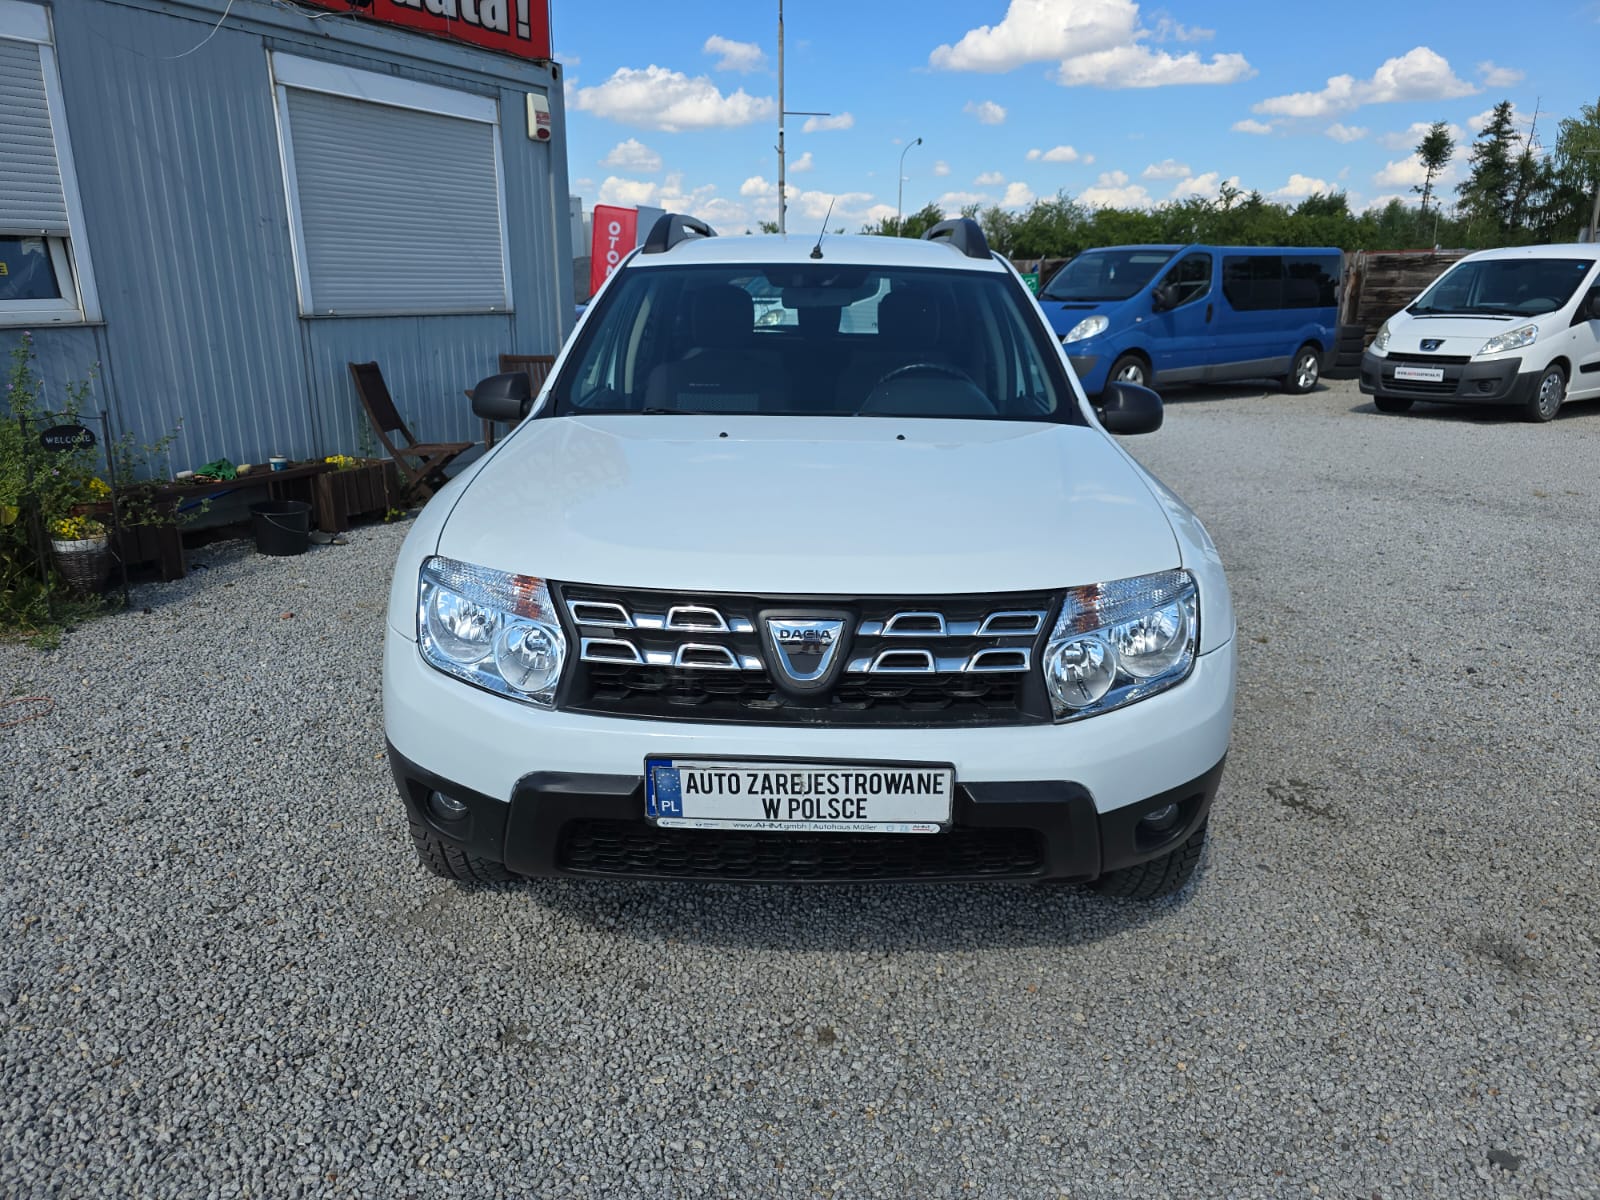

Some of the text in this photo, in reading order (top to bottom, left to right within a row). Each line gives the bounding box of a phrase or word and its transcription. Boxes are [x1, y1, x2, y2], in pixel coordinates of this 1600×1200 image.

[389, 0, 531, 41] ata!
[46, 434, 91, 444] WELCOE
[780, 629, 832, 640] DACIA
[685, 772, 945, 796] AUTO ZAREJESTROWANE
[661, 800, 680, 812] PL
[761, 797, 868, 820] W POLSCE
[813, 823, 851, 832] Autohaus
